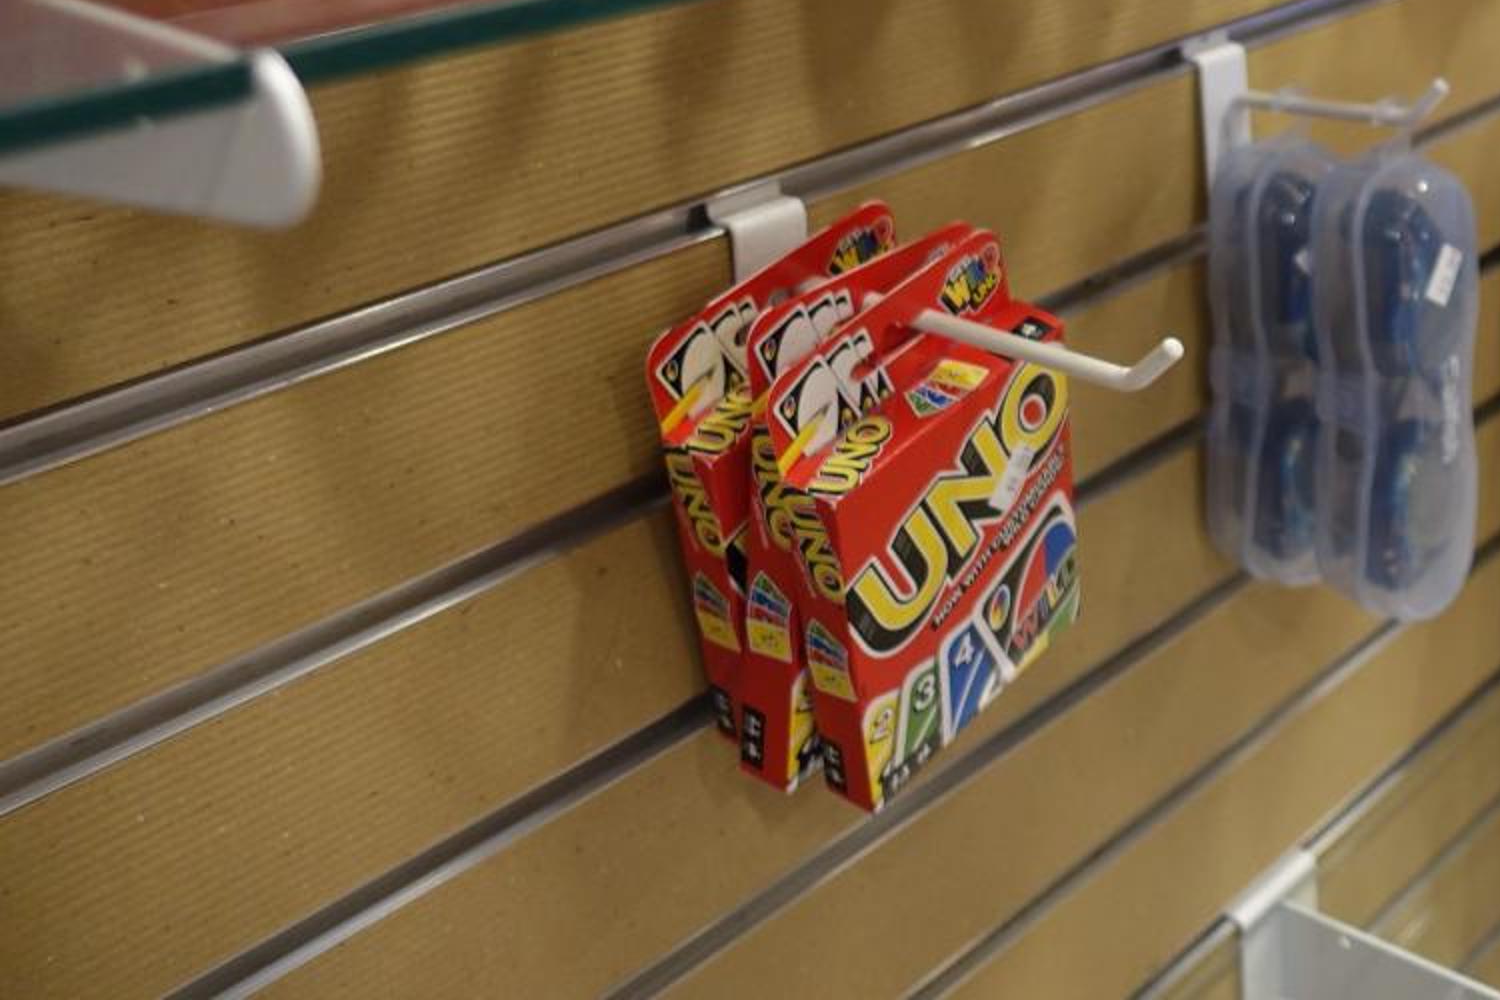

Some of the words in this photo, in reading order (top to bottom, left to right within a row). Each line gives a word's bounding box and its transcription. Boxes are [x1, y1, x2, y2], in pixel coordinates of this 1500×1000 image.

[806, 415, 892, 496] UNO
[848, 360, 1070, 650] UNO
[782, 492, 847, 603] UNO
[954, 630, 976, 669] 4
[913, 673, 938, 713] 3
[871, 706, 895, 741] 2
